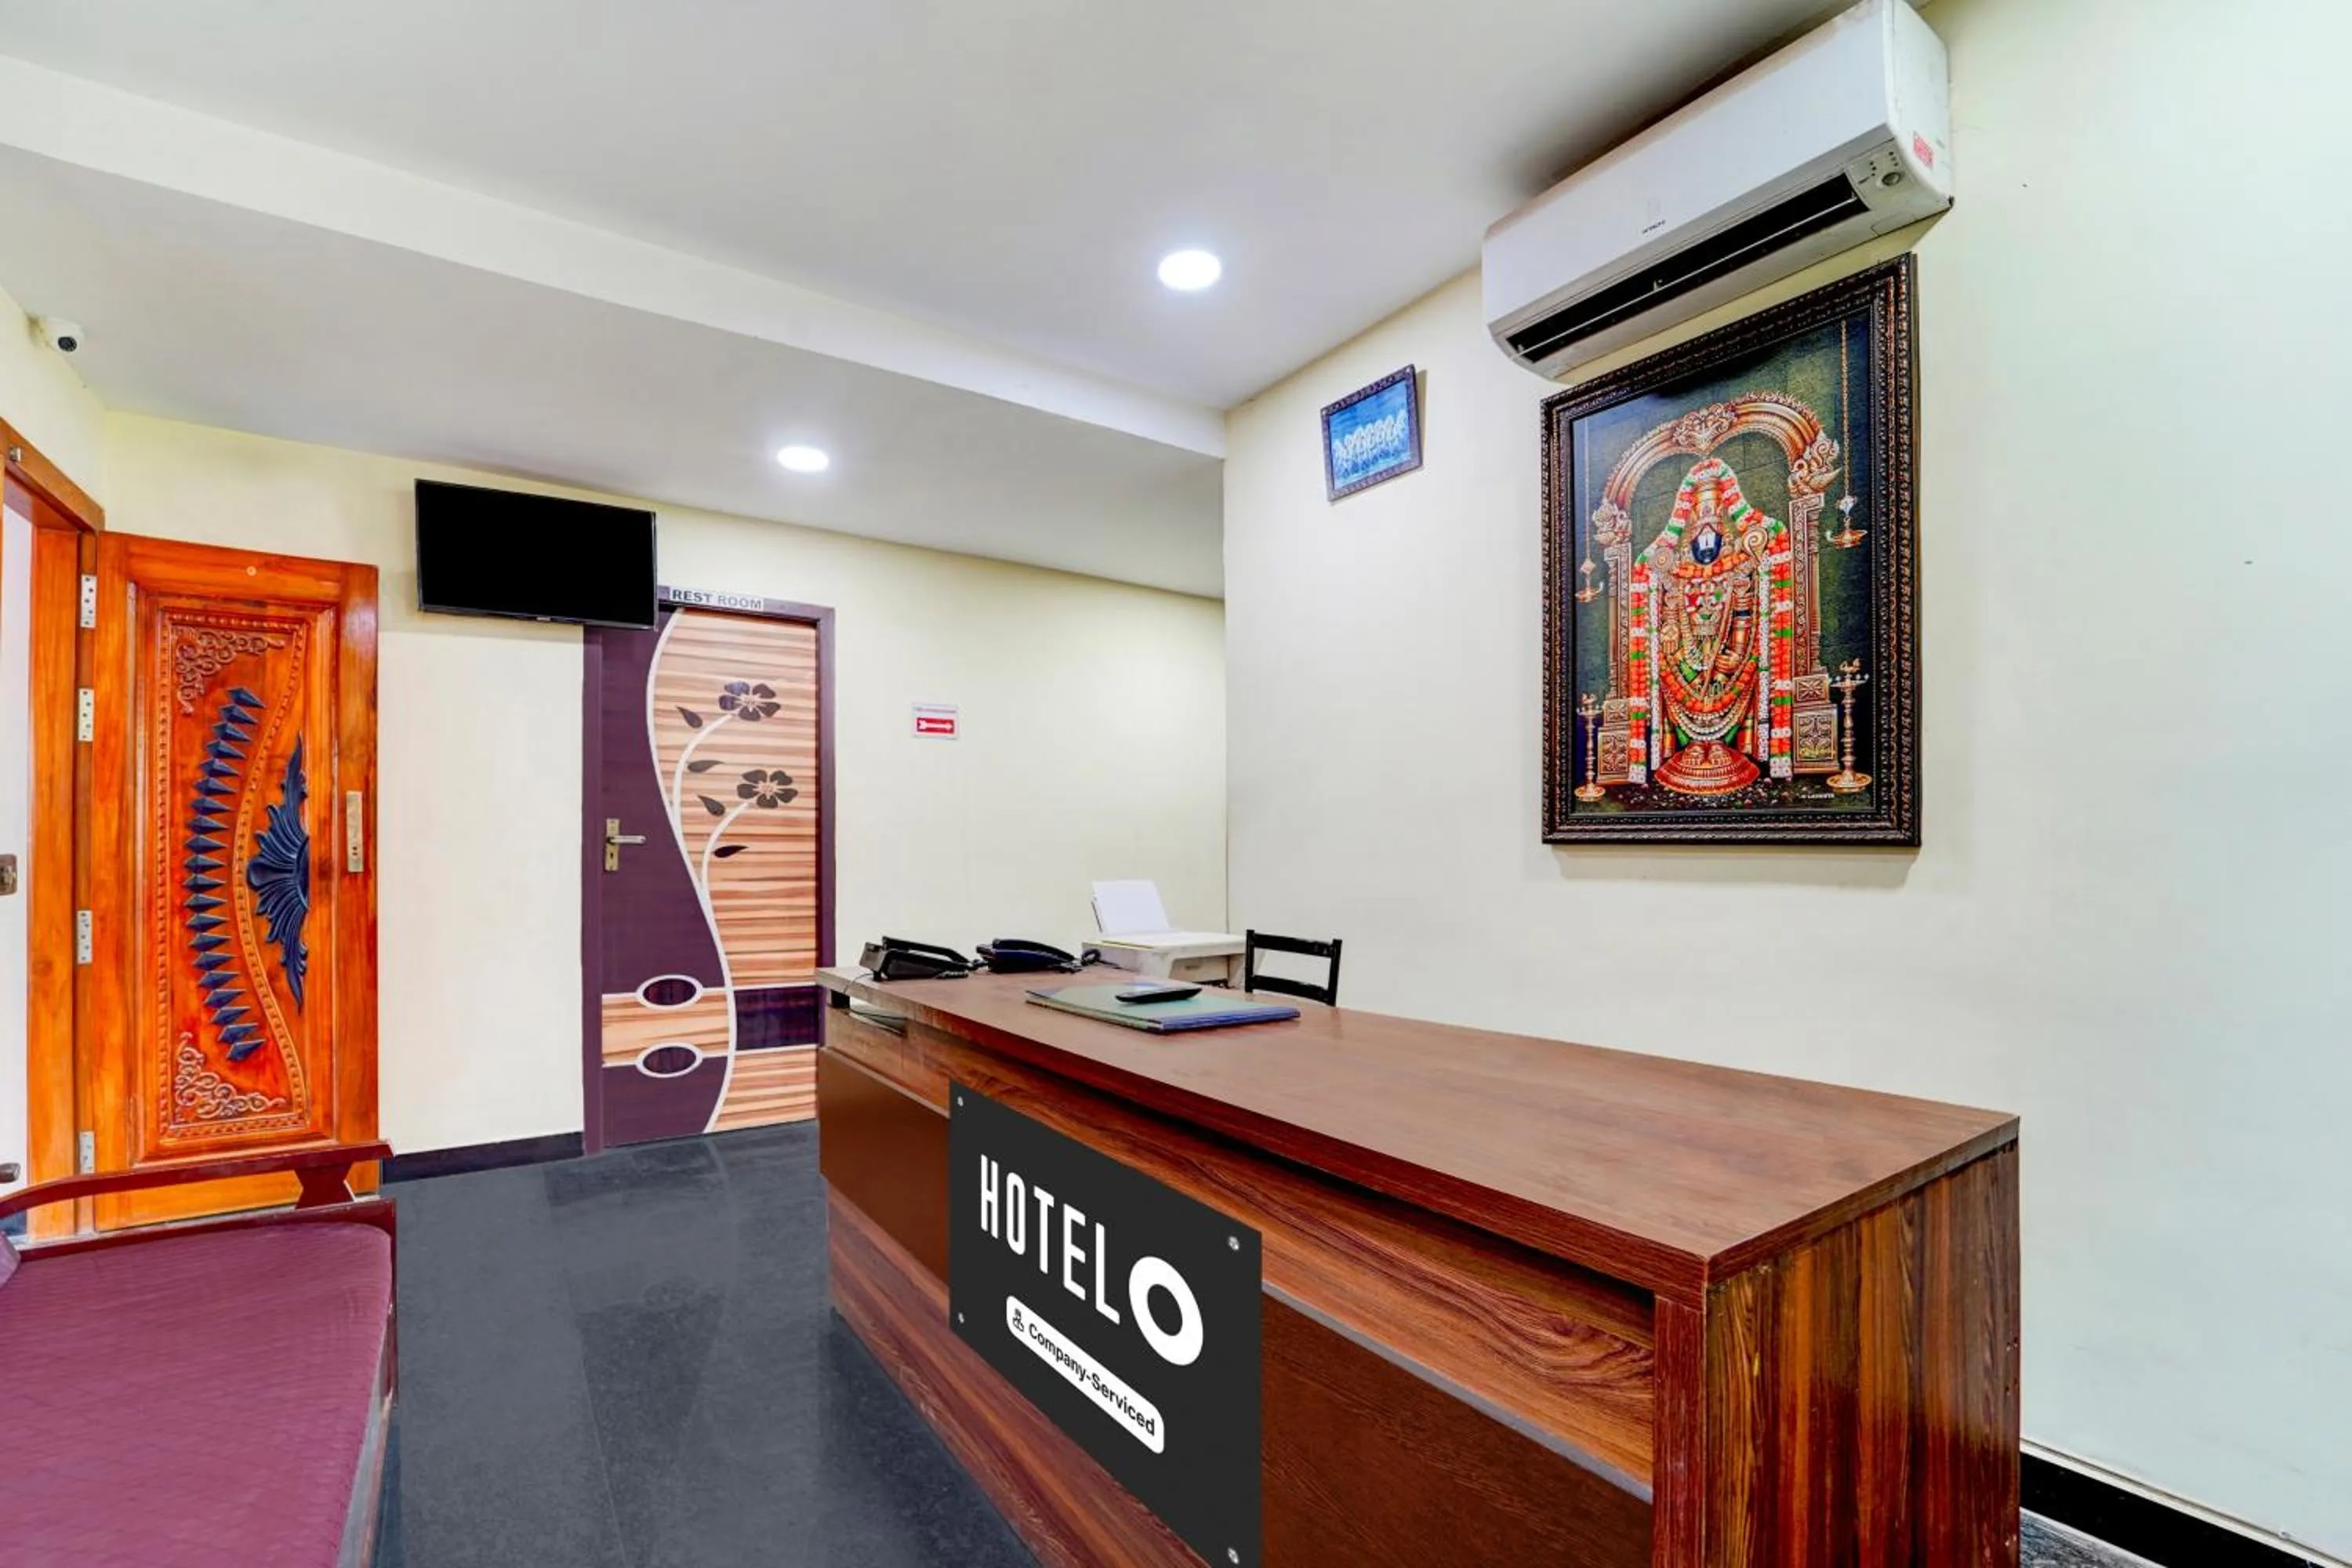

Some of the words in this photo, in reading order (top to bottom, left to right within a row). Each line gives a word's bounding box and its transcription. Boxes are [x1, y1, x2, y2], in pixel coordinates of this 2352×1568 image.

[672, 589, 713, 603] REST
[717, 595, 761, 609] ROOM
[1029, 1323, 1155, 1436] Company-Serviced
